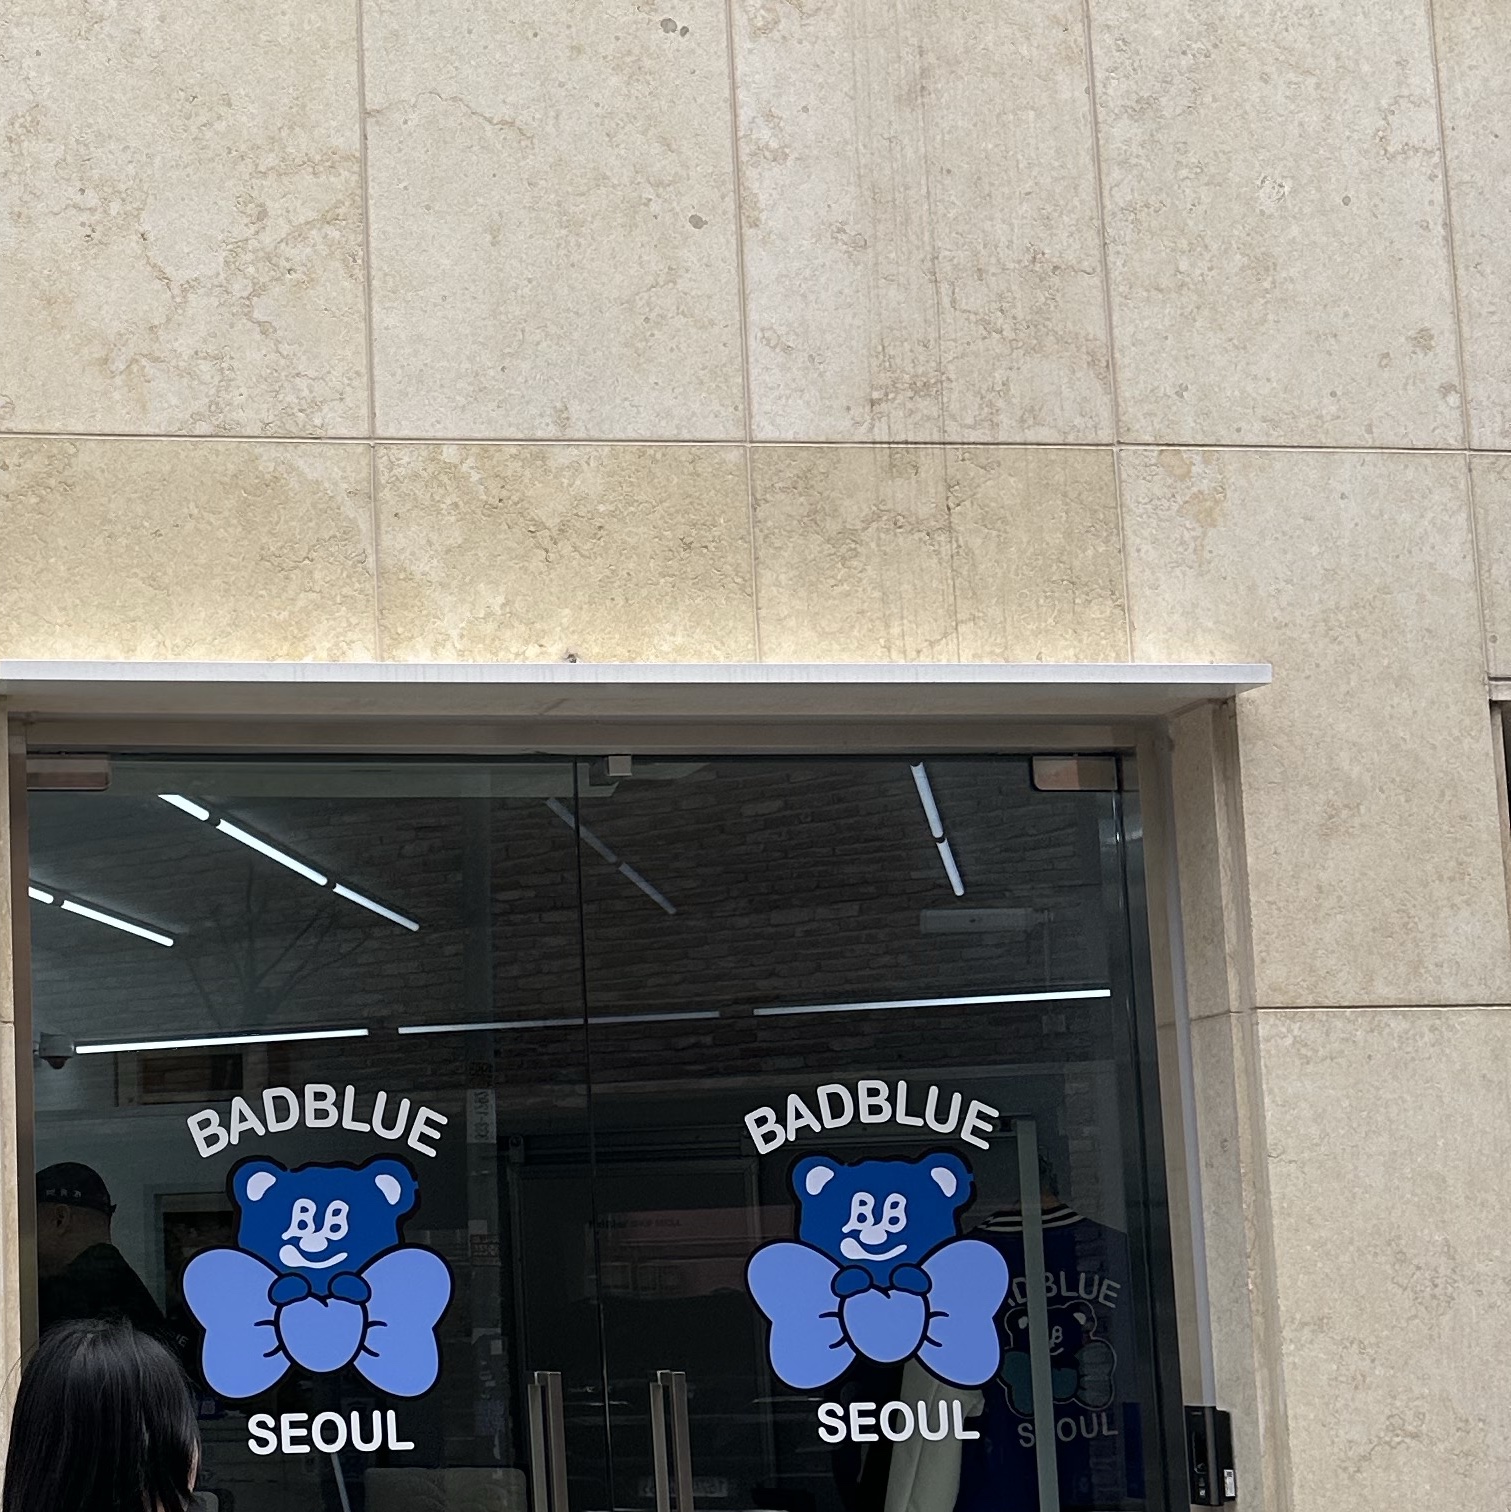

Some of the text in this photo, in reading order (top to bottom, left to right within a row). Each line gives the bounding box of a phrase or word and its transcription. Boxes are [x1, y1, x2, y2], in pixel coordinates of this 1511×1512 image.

[186, 1083, 448, 1159] BADBLUE
[744, 1079, 1000, 1155] BADBLUE
[1008, 1270, 1122, 1308] DBLUE
[247, 1410, 415, 1456] SEOUL
[817, 1400, 980, 1444] SEOUL
[1017, 1411, 1119, 1448] SOUL
